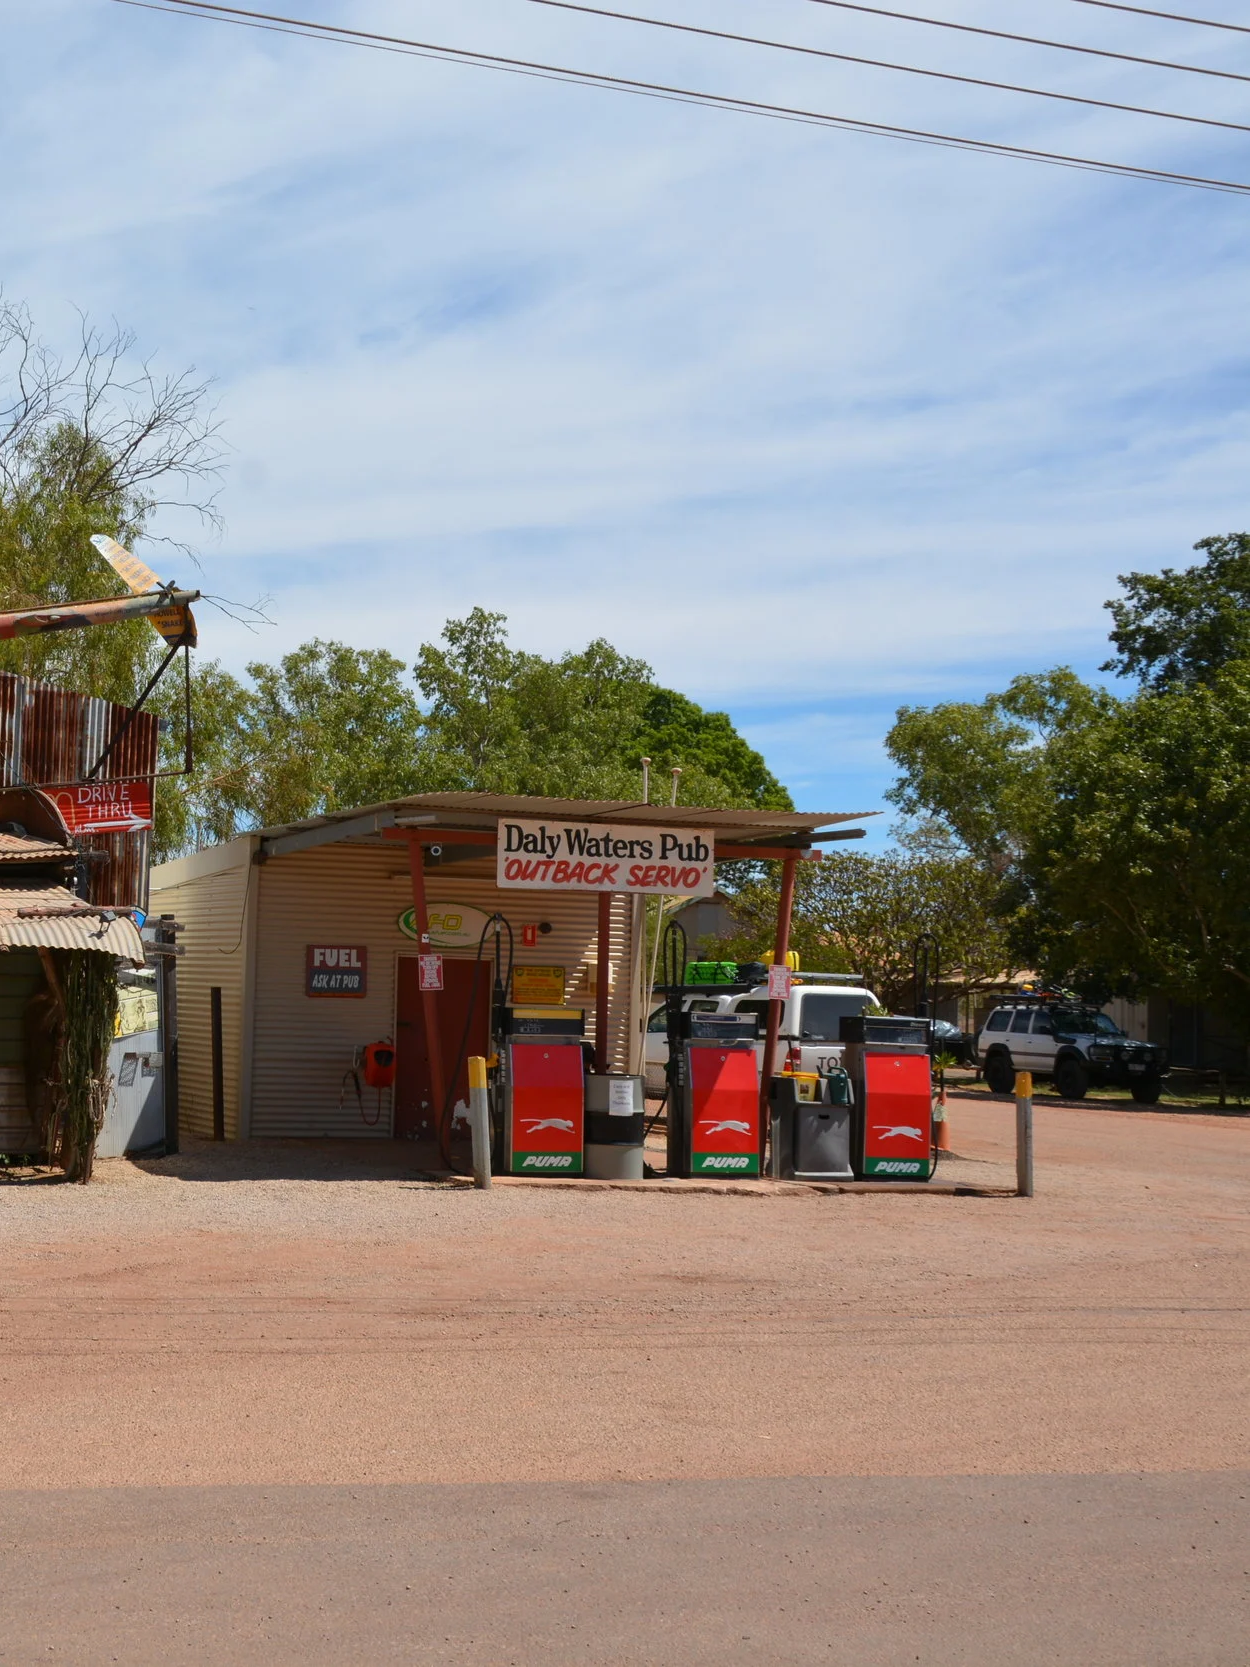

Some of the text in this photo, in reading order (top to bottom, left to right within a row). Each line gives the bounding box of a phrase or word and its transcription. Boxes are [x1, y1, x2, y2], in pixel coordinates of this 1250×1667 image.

[77, 783, 131, 804] DRIVE
[85, 801, 132, 820] THRU
[504, 824, 710, 862] Daly Waters Pub
[313, 948, 362, 968] FUEL
[312, 974, 360, 989] ASK AT PUB
[817, 1056, 842, 1070] TO
[521, 1155, 573, 1167] PUMA
[702, 1156, 750, 1169] PUMA
[874, 1160, 921, 1173] PUMA
